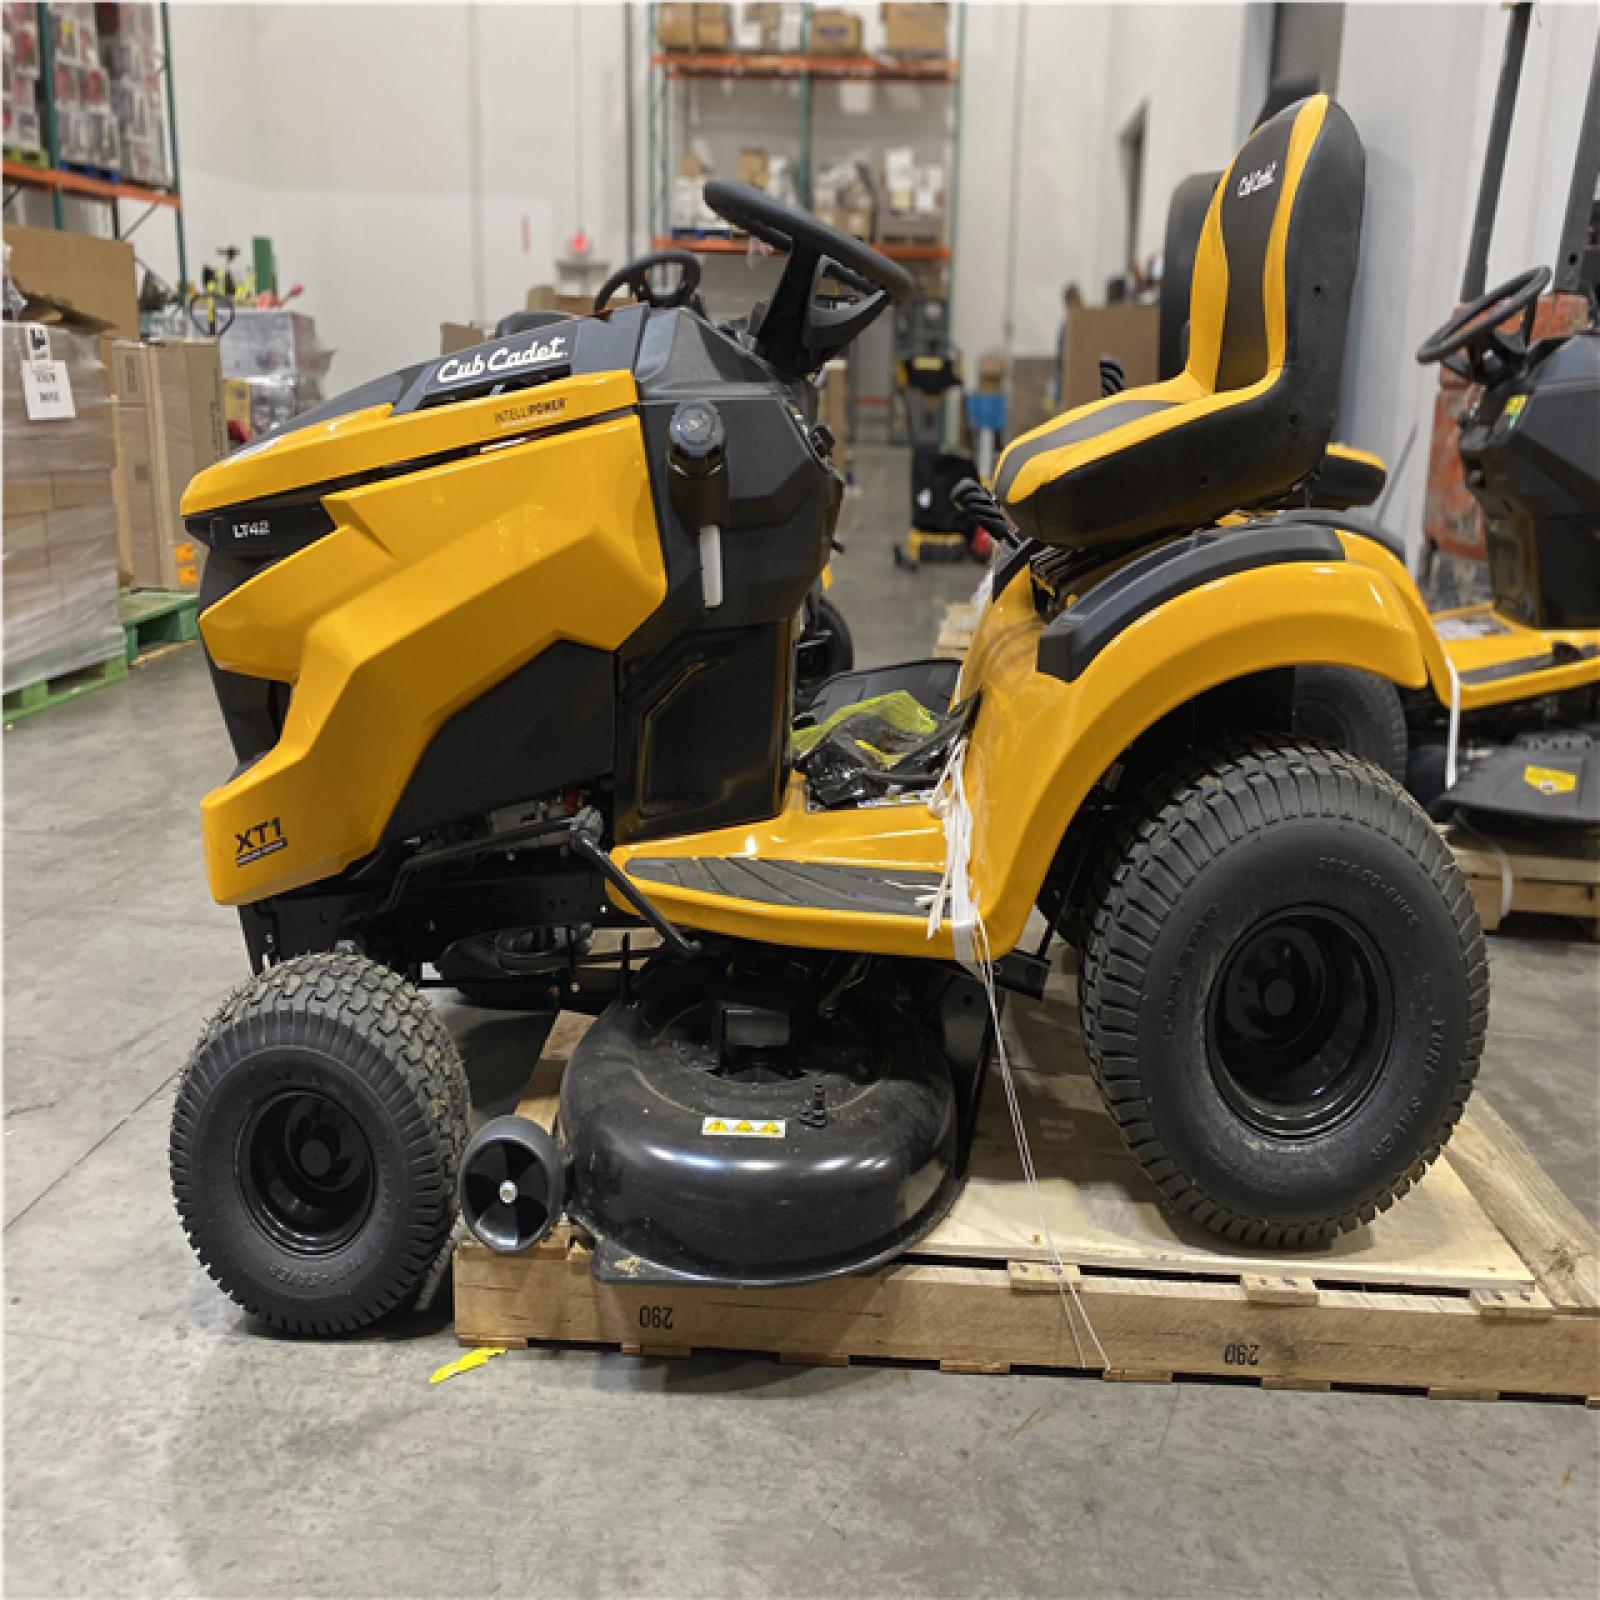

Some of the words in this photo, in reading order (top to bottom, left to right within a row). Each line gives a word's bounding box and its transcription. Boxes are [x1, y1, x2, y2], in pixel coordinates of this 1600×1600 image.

[437, 353, 485, 382] Cub
[487, 337, 568, 371] Cadet
[232, 520, 271, 539] LT42
[234, 816, 281, 853] XT1
[639, 1305, 673, 1330] 290
[1224, 1343, 1260, 1366] 290
